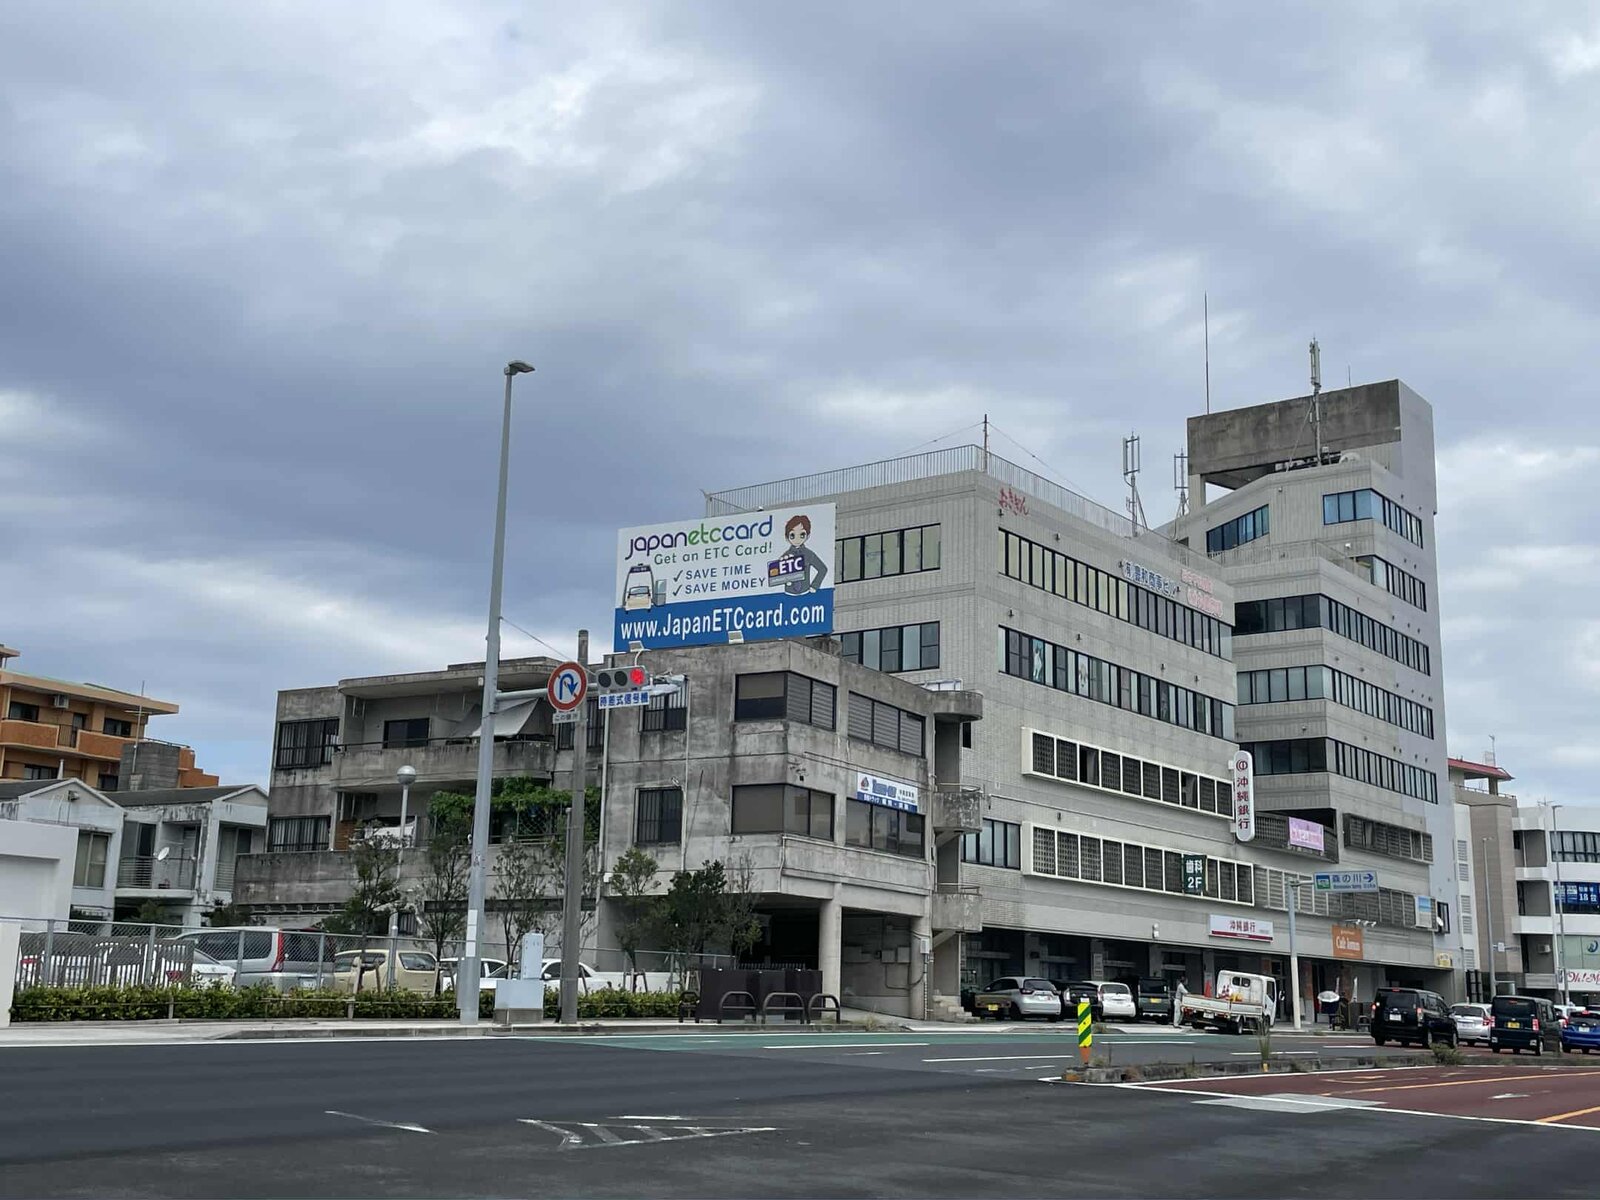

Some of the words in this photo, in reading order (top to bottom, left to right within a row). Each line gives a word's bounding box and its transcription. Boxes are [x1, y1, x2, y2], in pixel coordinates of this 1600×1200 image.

[624, 515, 773, 560] japanetccard
[654, 553, 677, 565] Get
[683, 554, 699, 562] an
[705, 547, 730, 560] ETC
[735, 543, 773, 556] Card!
[685, 567, 718, 580] SAVE
[723, 564, 752, 576] TIME
[779, 557, 803, 575] ETC
[685, 581, 718, 594] SAVE
[721, 577, 766, 591] MONEY
[620, 603, 825, 641] www.JapanETCcard.com
[600, 692, 649, 706] 時差式信号機
[1237, 776, 1250, 829] 沖縄銀行
[1186, 859, 1203, 874] 歯科
[1187, 876, 1203, 889] 2F
